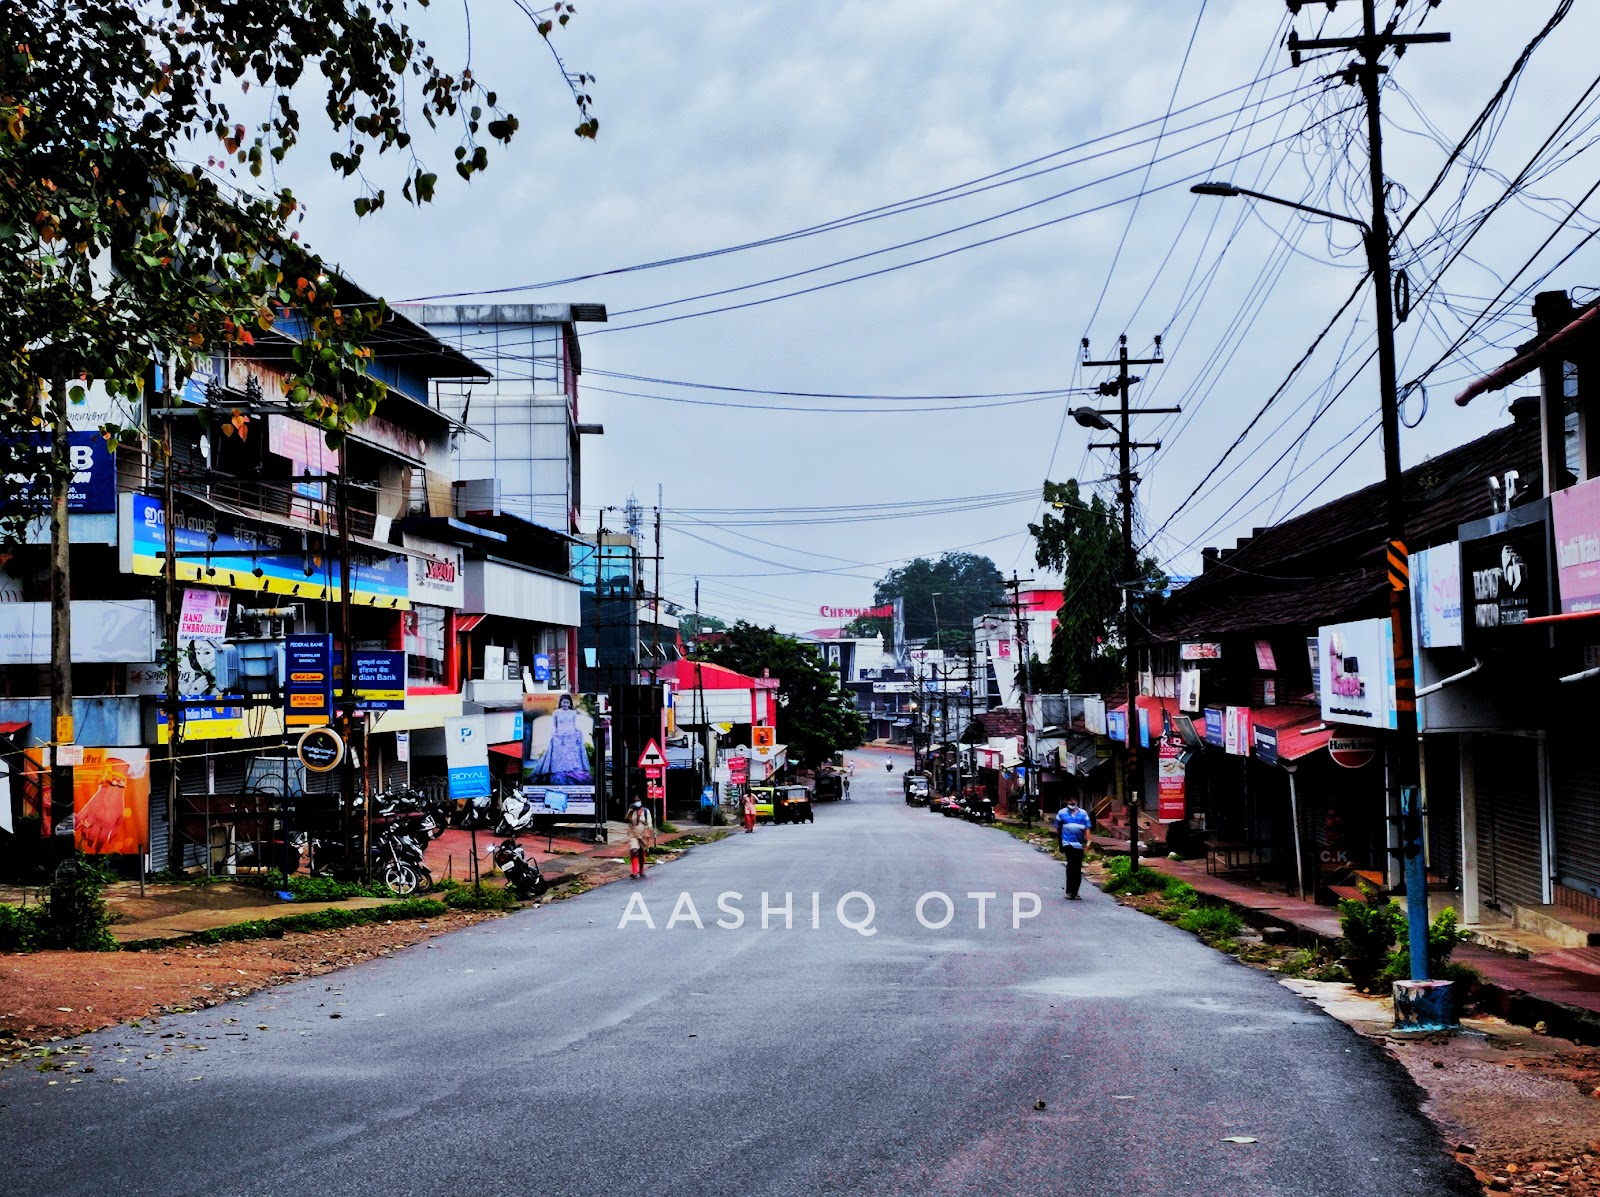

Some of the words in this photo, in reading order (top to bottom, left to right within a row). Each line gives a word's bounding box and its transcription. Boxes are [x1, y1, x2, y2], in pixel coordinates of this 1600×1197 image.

[183, 613, 202, 623] HAND
[181, 623, 223, 634] EMBROIDERY
[1329, 740, 1376, 751] Hawkins
[451, 771, 487, 781] ROYAL
